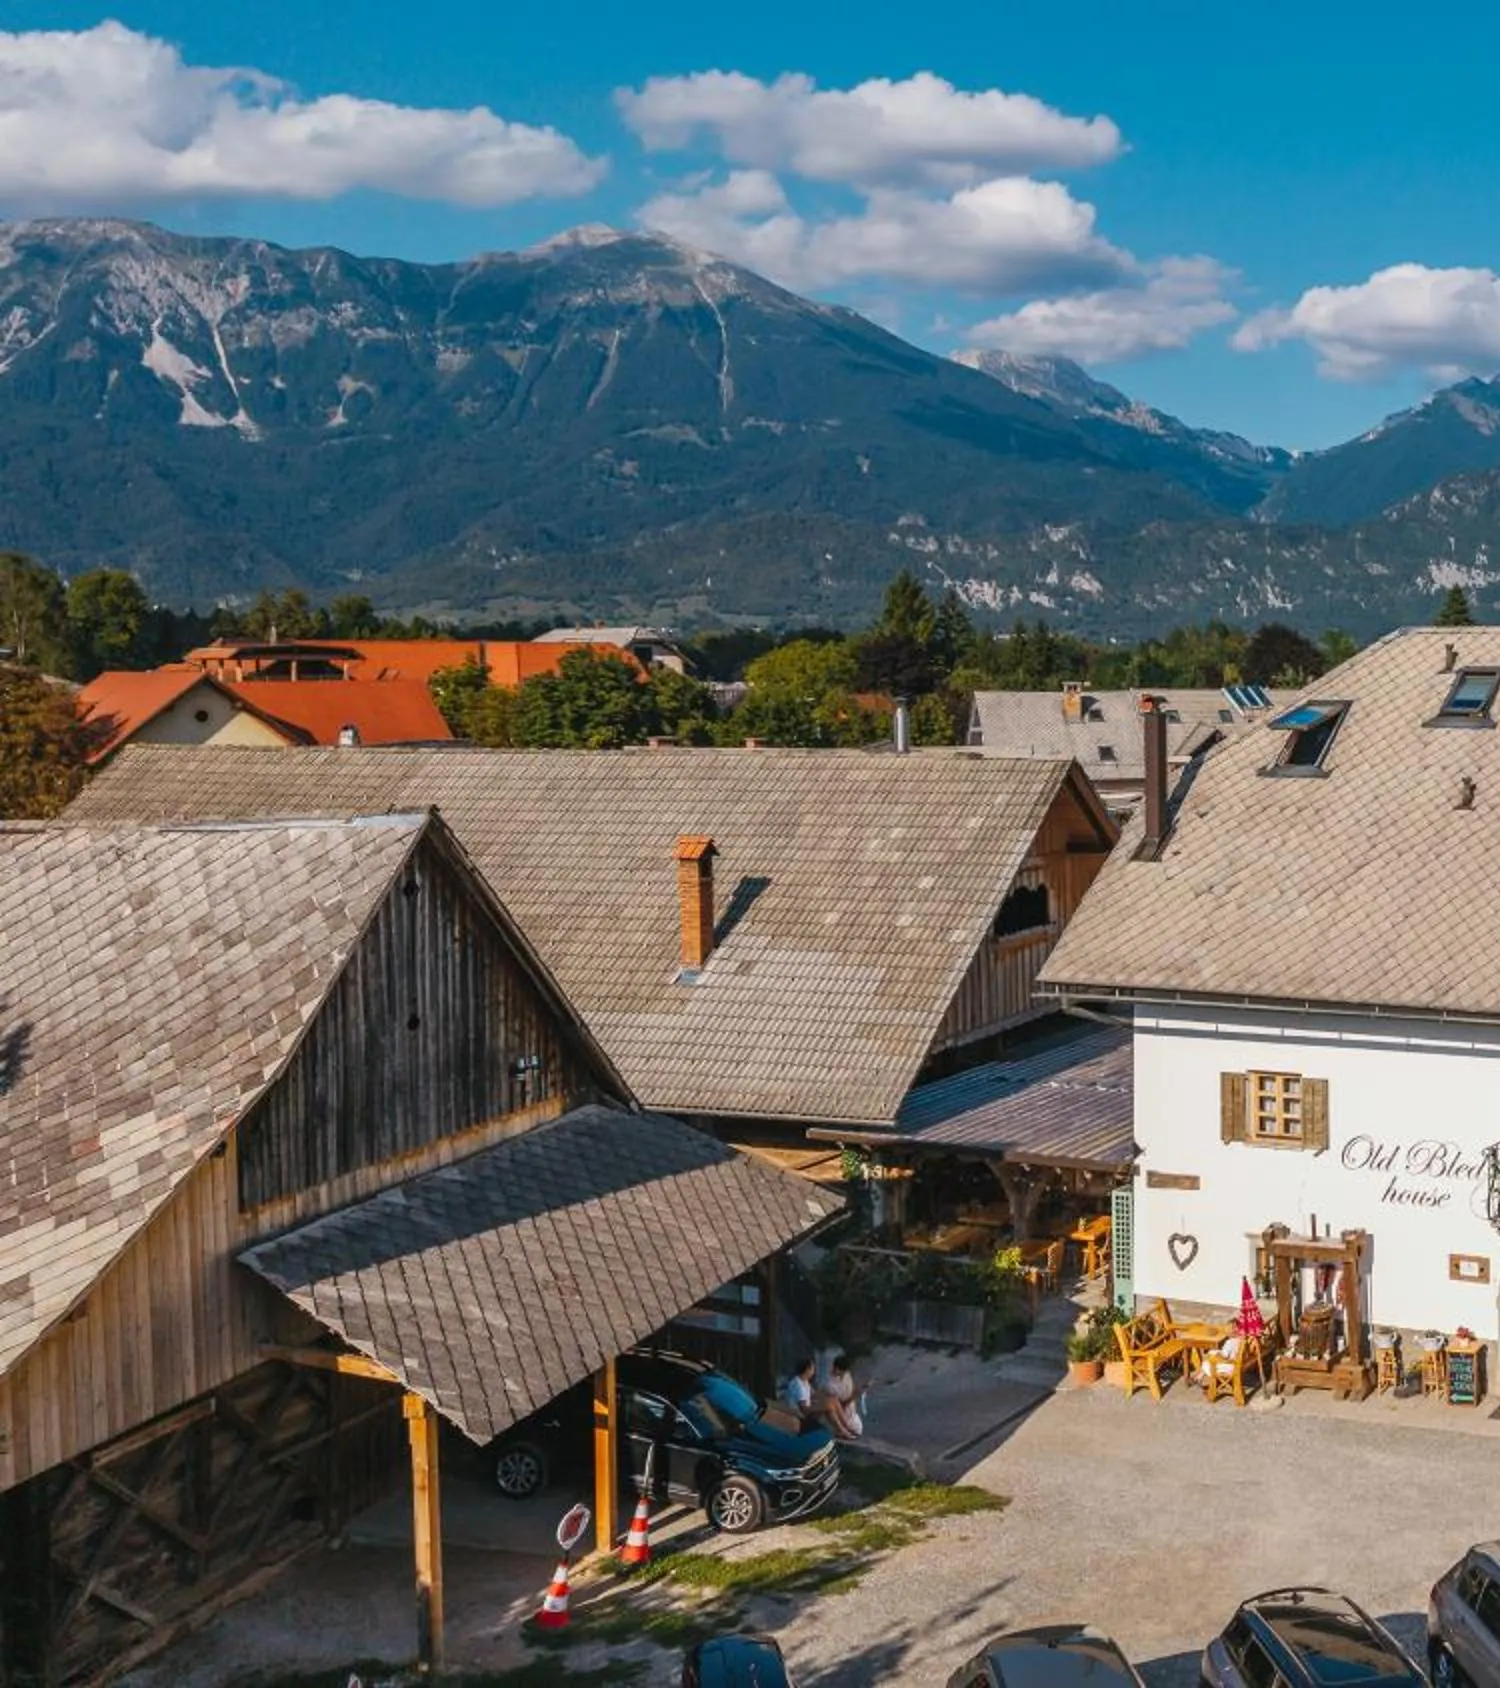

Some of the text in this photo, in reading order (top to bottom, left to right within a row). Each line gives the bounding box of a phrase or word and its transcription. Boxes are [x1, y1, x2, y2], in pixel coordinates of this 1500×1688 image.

[1341, 1134, 1487, 1180] Old Bled
[1382, 1176, 1451, 1207] house
